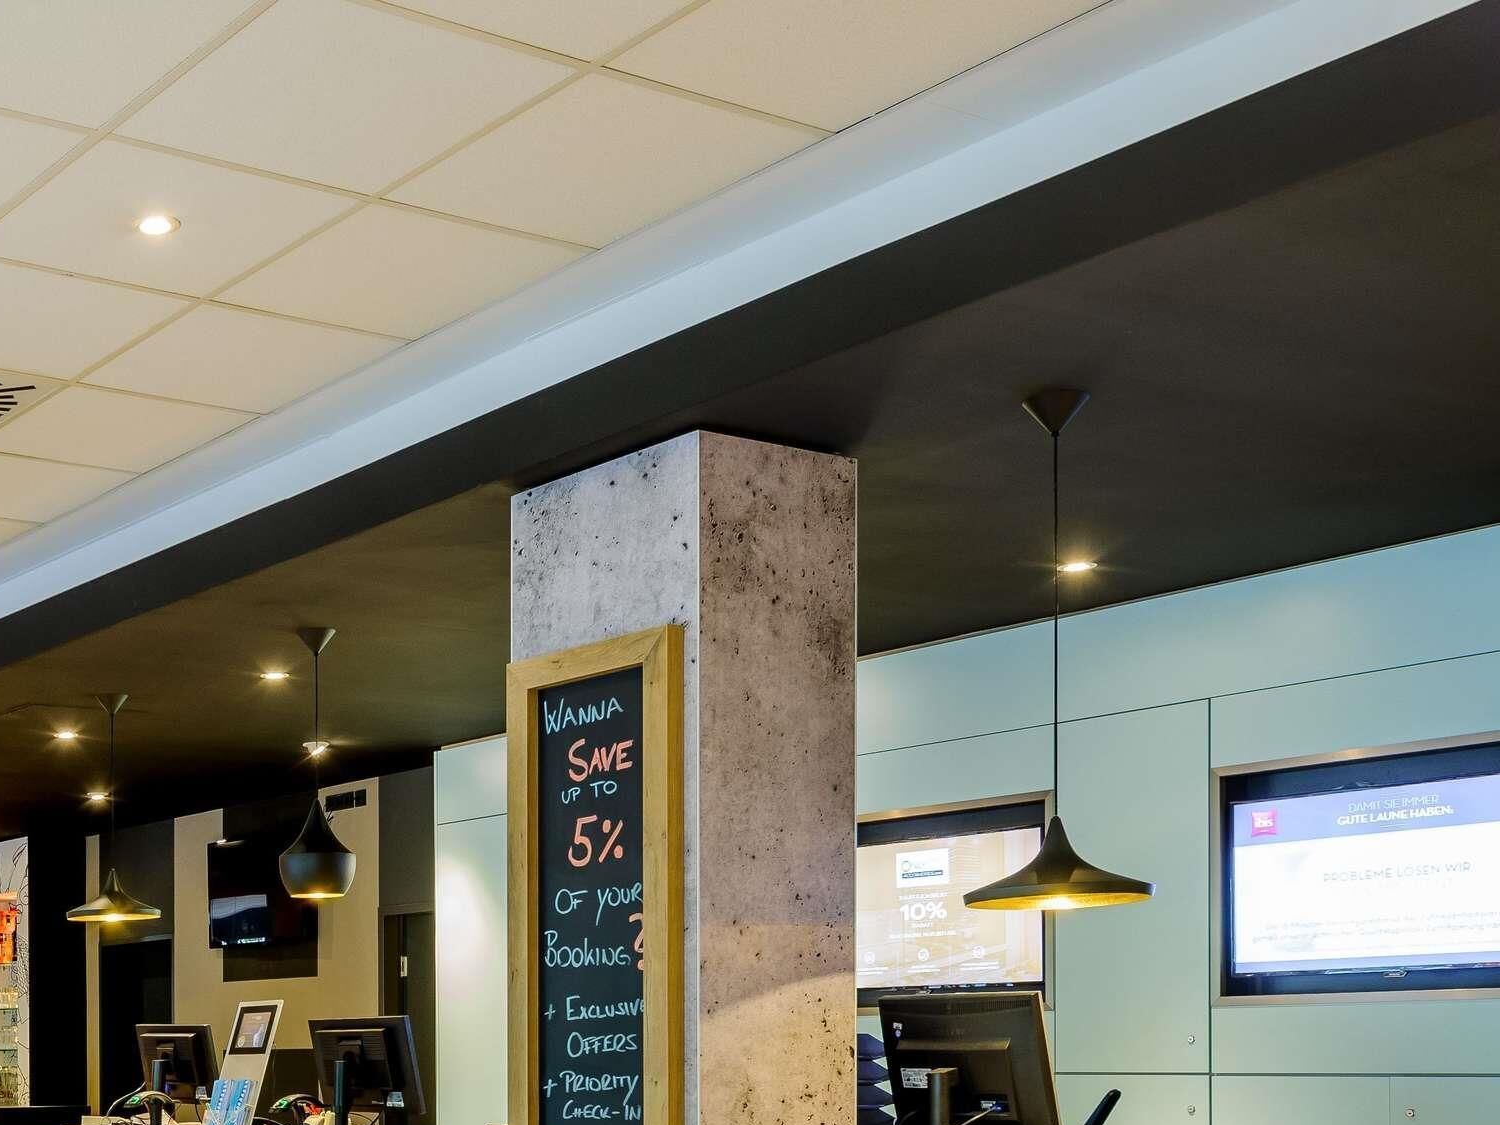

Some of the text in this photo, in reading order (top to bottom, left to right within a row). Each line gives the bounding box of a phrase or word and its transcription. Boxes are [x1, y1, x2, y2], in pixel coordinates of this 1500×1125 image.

[543, 697, 624, 735] WANNA
[568, 738, 634, 783] SAVE
[561, 780, 618, 804] UP TO
[1336, 814, 1369, 826] GUTE
[1370, 809, 1408, 823] LAUNE
[568, 814, 624, 868] 5%
[555, 881, 643, 927] OF YOUR
[900, 901, 947, 920] 10%
[567, 1031, 638, 1059] OFFERS
[559, 1071, 640, 1105] PRIORITY
[562, 1103, 641, 1121] CHECK-IN
